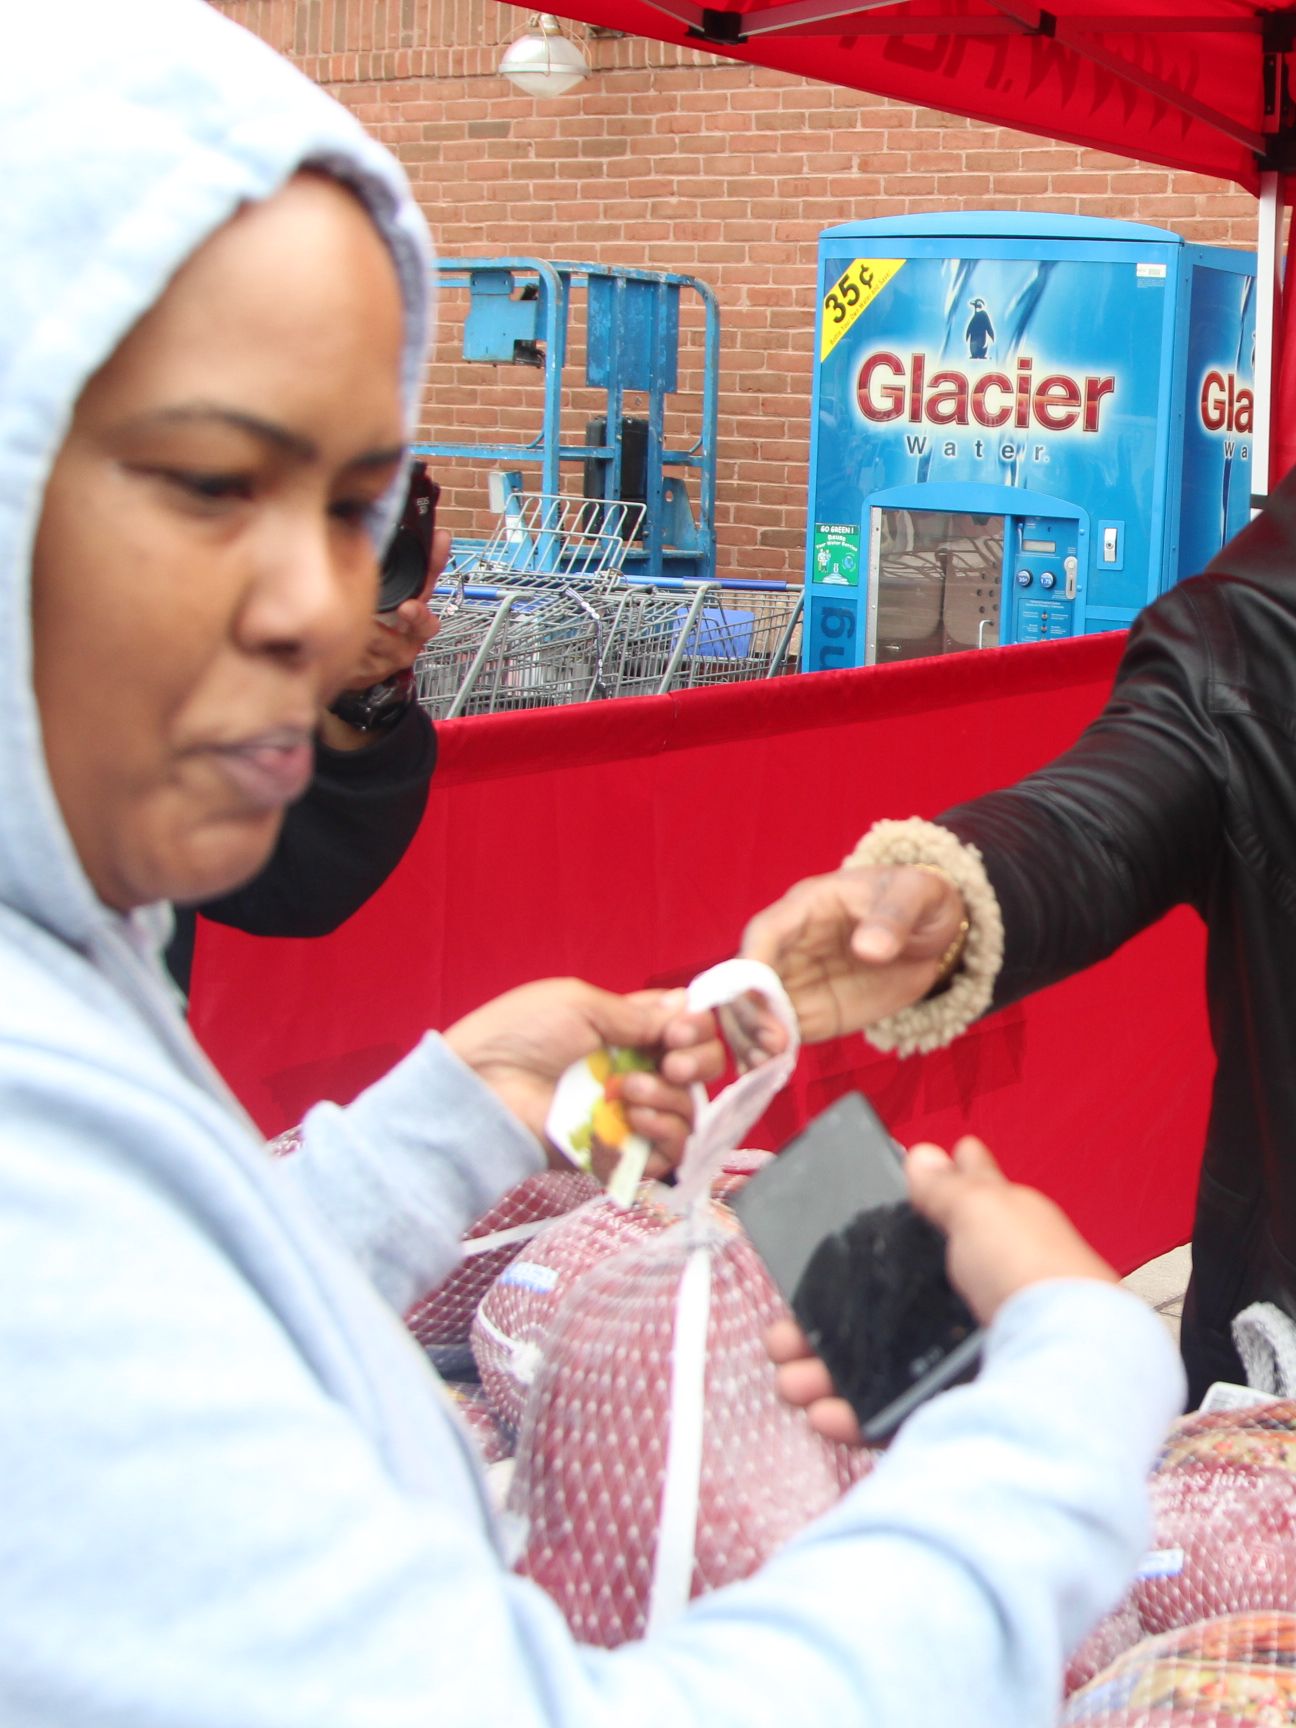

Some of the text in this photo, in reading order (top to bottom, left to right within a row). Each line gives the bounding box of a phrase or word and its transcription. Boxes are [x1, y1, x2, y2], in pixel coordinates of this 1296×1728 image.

[857, 350, 1115, 432] Glacier
[906, 435, 1044, 461] Water
[820, 525, 829, 533] GO
[830, 525, 850, 534] GREEN
